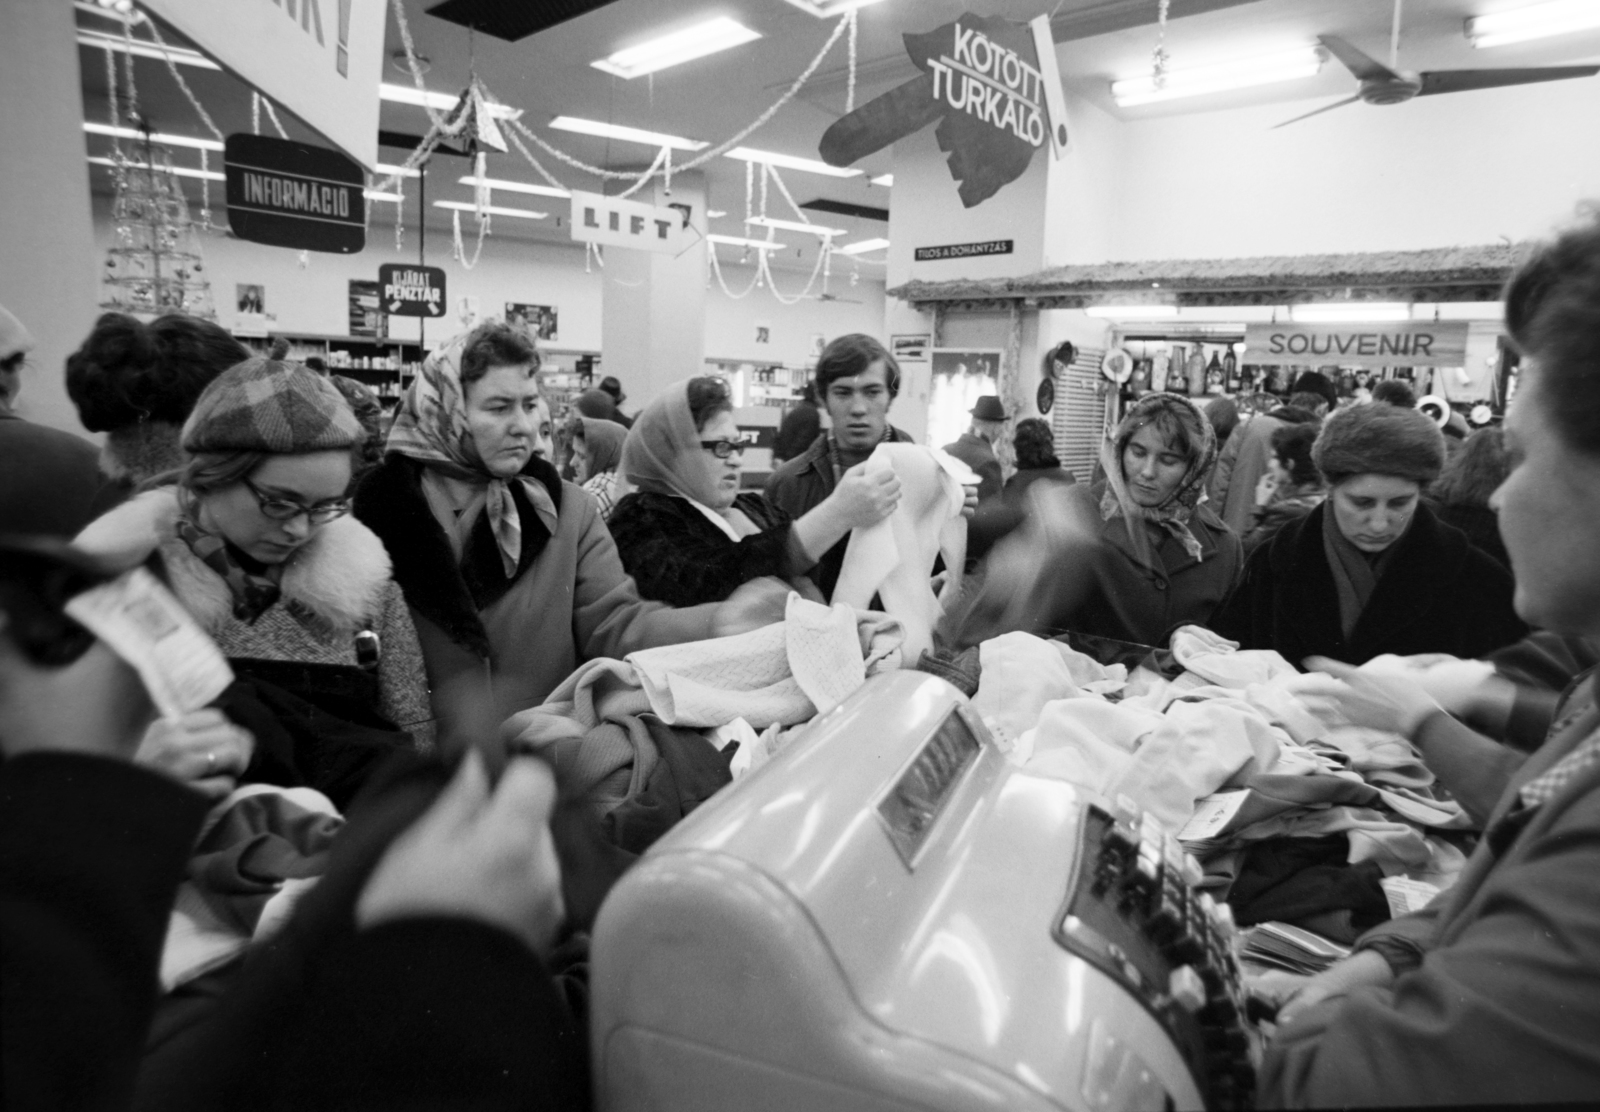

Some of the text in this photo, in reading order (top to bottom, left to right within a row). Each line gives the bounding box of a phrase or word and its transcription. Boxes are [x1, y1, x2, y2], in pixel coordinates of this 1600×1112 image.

[926, 57, 1044, 147] TURKÁLÓ
[584, 207, 671, 239] LIFT
[917, 248, 941, 259] TILOS
[942, 247, 949, 258] A
[1269, 333, 1434, 356] SOUVENIR
